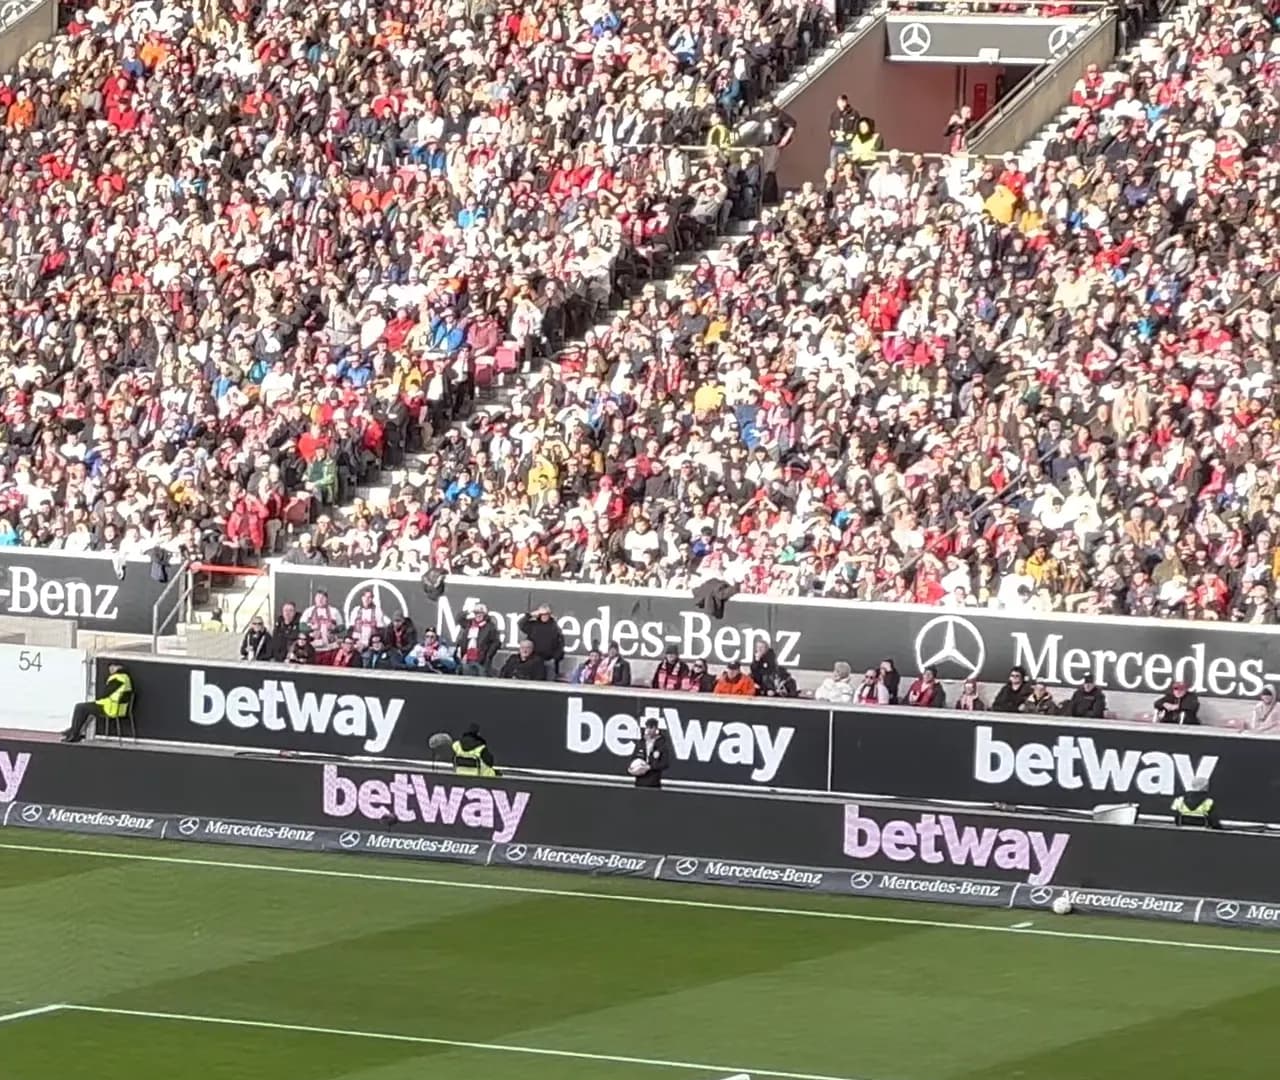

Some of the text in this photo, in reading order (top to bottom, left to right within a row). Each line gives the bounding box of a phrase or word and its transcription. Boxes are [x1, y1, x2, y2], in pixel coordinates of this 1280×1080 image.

[435, 595, 801, 667] Meredes-Benz
[18, 651, 42, 672] 54
[190, 670, 404, 752] betway
[322, 764, 531, 843] betway
[47, 808, 154, 829] Mercedes-Benz
[205, 821, 315, 842] Mercedes-Benz
[366, 834, 479, 855] Mercedes-Benz
[843, 804, 1070, 886] betway
[533, 848, 646, 869] Mercedes-Benz
[704, 861, 822, 884] Mercedes-Benz
[879, 875, 1001, 898] Mercedes-Benz
